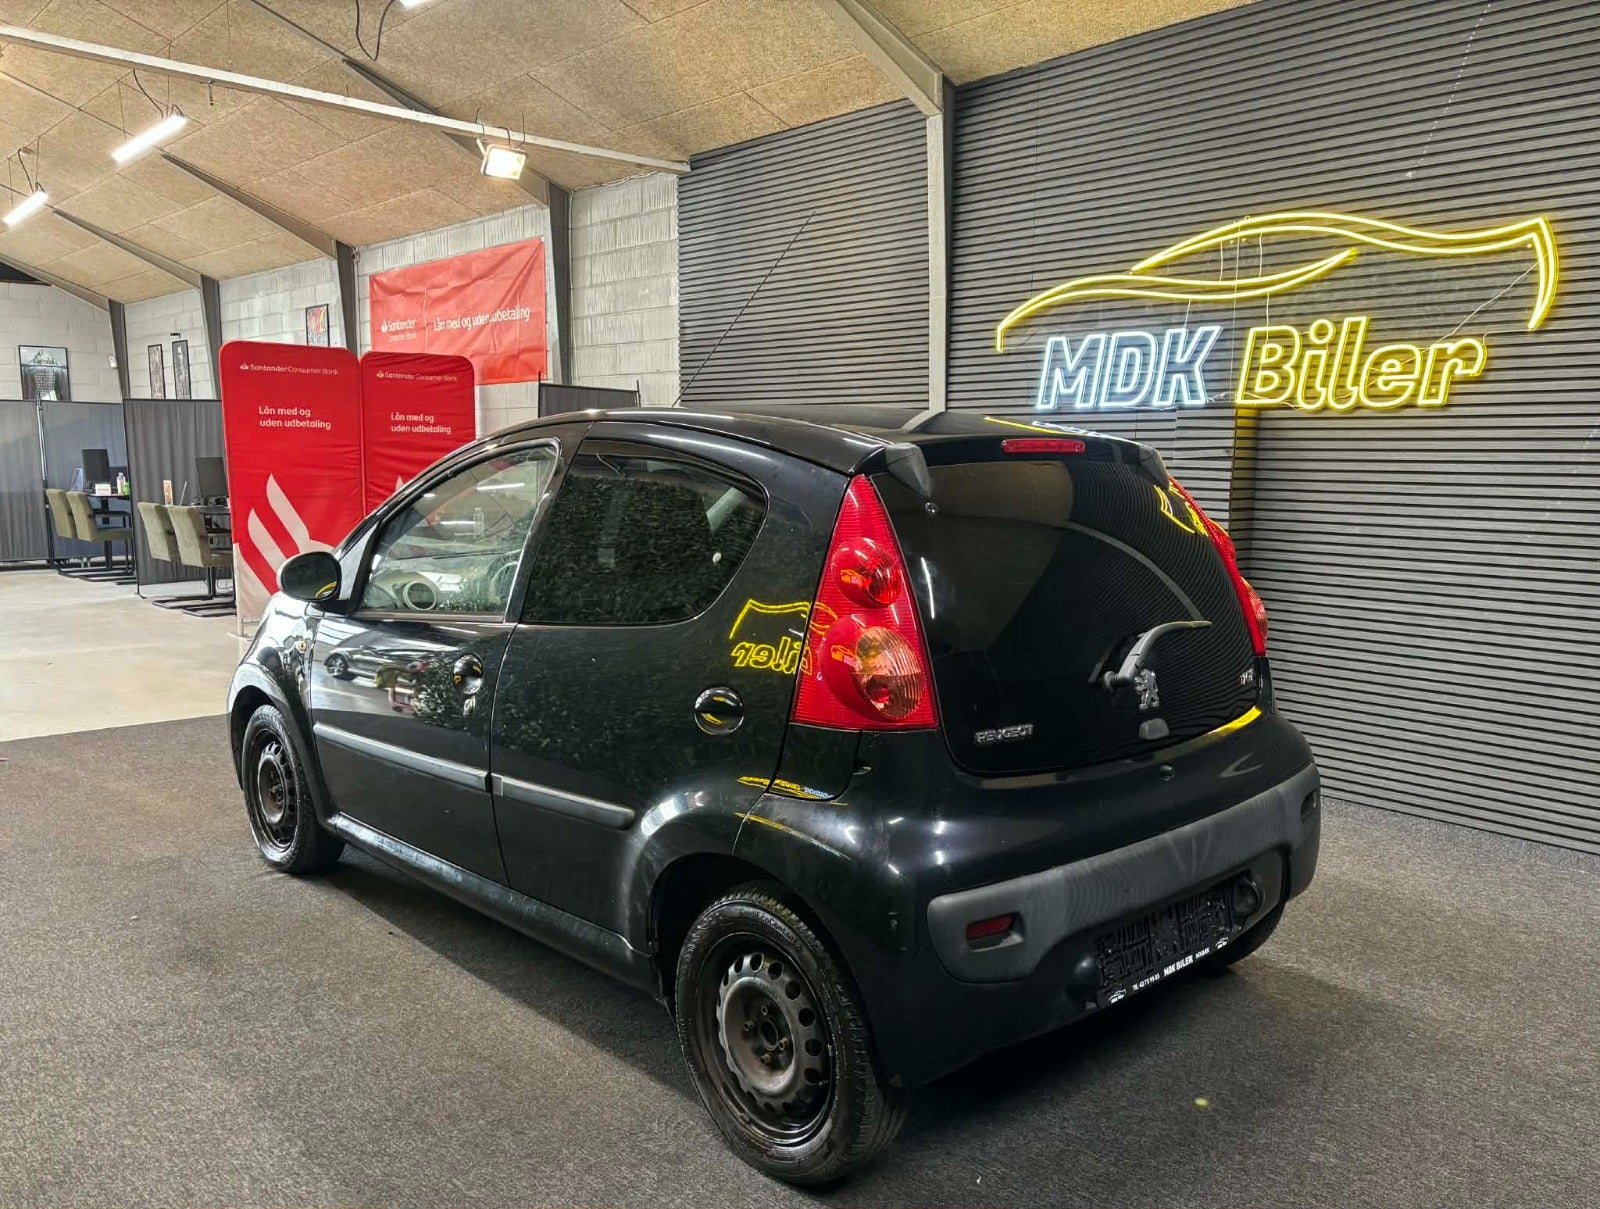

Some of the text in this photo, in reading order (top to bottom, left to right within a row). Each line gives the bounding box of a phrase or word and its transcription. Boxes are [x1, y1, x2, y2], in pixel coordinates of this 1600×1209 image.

[433, 317, 445, 331] Lån
[446, 316, 461, 330] med
[461, 317, 472, 330] og
[249, 363, 338, 376] Santander Consumer Bank
[1036, 316, 1487, 410] MDK Biler
[384, 371, 414, 380] Santander
[258, 405, 311, 418] Lån med og
[391, 412, 435, 424] Lån med og
[259, 418, 331, 431] uden udbetaling
[391, 424, 451, 435] uden udbetaling
[974, 724, 1034, 744] PEUGEOT
[1176, 955, 1194, 971] BILER
